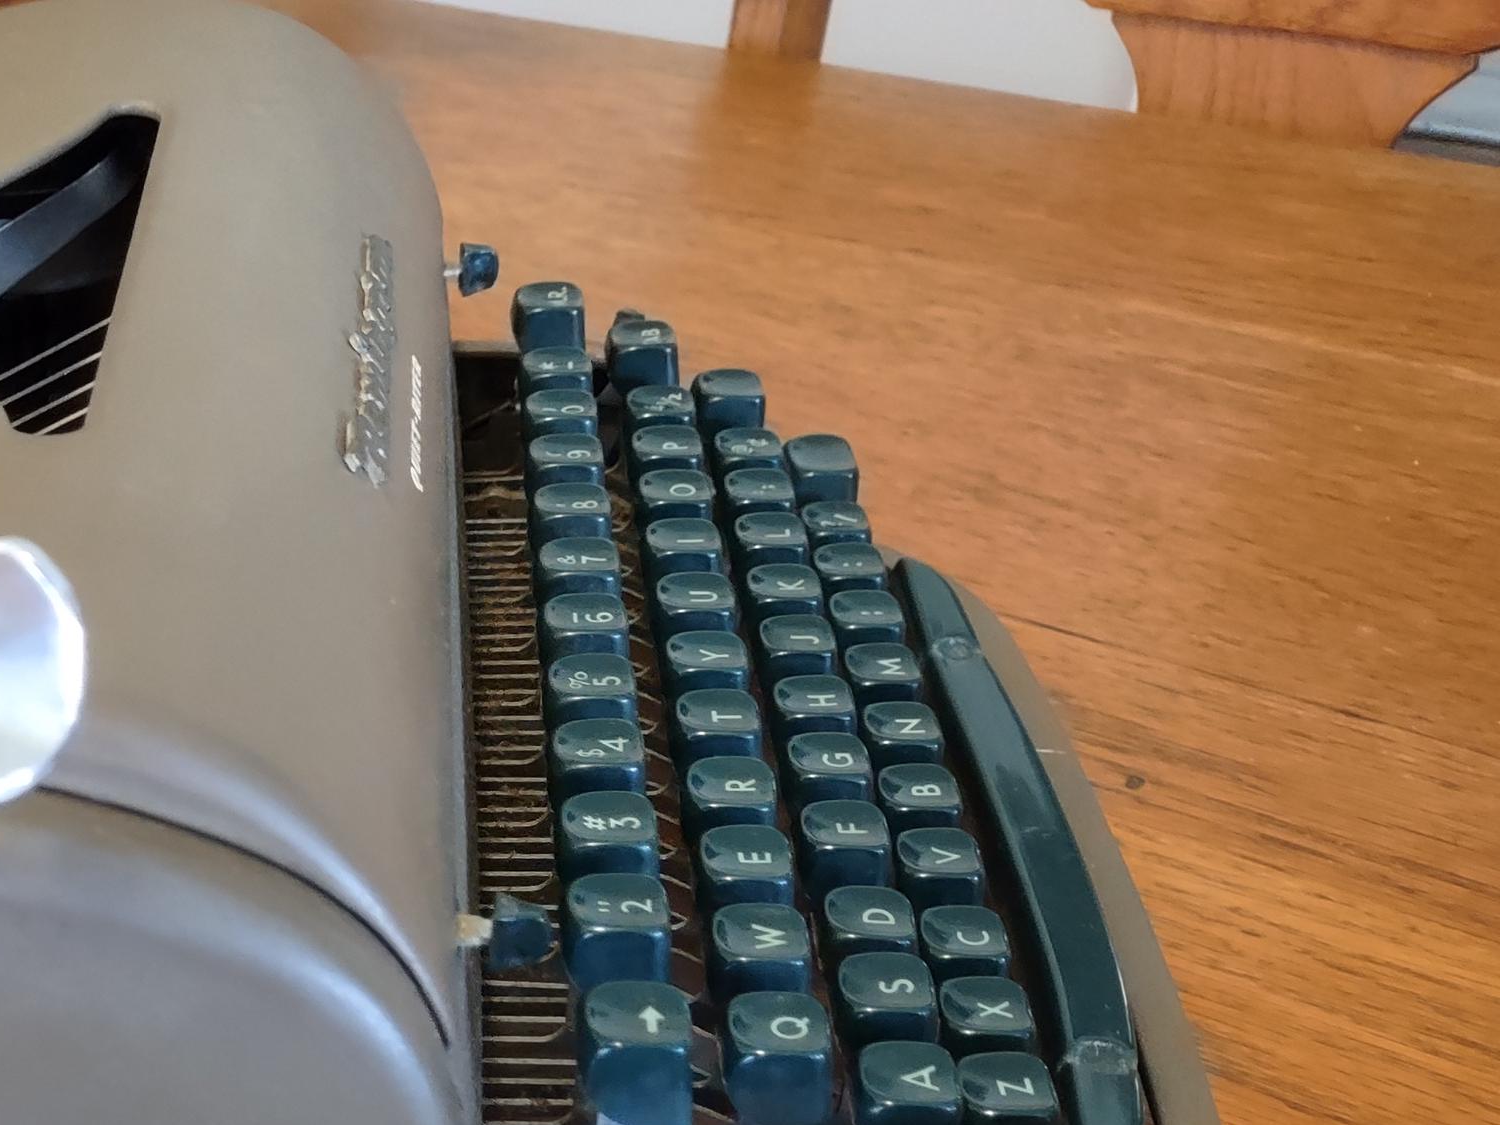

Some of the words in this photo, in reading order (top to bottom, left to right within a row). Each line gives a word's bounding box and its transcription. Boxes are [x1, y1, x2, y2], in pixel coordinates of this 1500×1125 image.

[663, 441, 689, 451] P
[567, 449, 591, 459] 9
[670, 483, 697, 497] O
[572, 500, 599, 509] 8
[767, 528, 791, 538] L
[581, 554, 608, 566] 7
[777, 579, 805, 591] K
[689, 590, 718, 603] U
[585, 611, 614, 623] 6
[791, 635, 820, 645] J
[700, 648, 730, 662] Y
[873, 658, 901, 676] M
[593, 676, 621, 688] 5
[807, 694, 838, 707] H
[711, 710, 743, 723] T
[901, 718, 925, 735] N
[599, 736, 629, 755] 4
[822, 752, 854, 768] G
[725, 779, 756, 793] R
[912, 783, 942, 797] B
[609, 816, 641, 829] 3
[836, 822, 869, 835] F
[738, 851, 773, 864] E
[934, 846, 962, 865] V
[621, 899, 653, 913] 2
[863, 908, 896, 925] D
[752, 923, 787, 950] W
[957, 930, 990, 946] C
[879, 978, 915, 994] S
[978, 1001, 1014, 1019] X
[771, 1016, 810, 1040] Q
[900, 1066, 940, 1091] A
[997, 1077, 1035, 1097] Z
